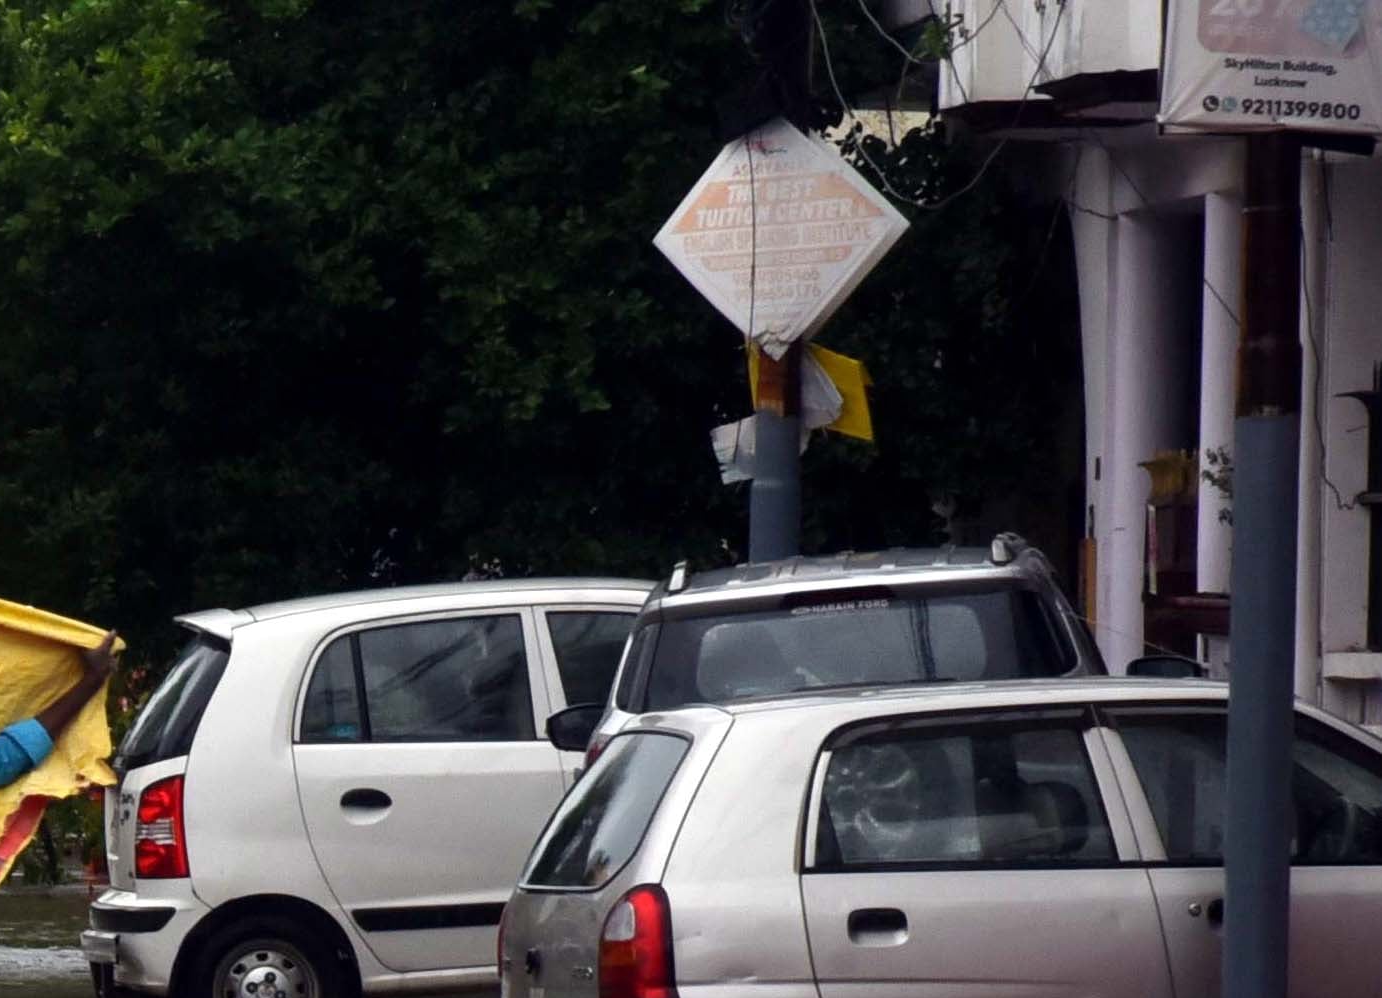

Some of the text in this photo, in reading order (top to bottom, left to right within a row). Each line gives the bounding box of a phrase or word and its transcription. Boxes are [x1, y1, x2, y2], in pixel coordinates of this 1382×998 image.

[1224, 57, 1337, 76] SkyHilton Building,
[1254, 75, 1308, 88] Lucknow
[1241, 99, 1361, 120] 9211399800
[697, 205, 772, 228] TUITION
[775, 197, 854, 221] CENTER
